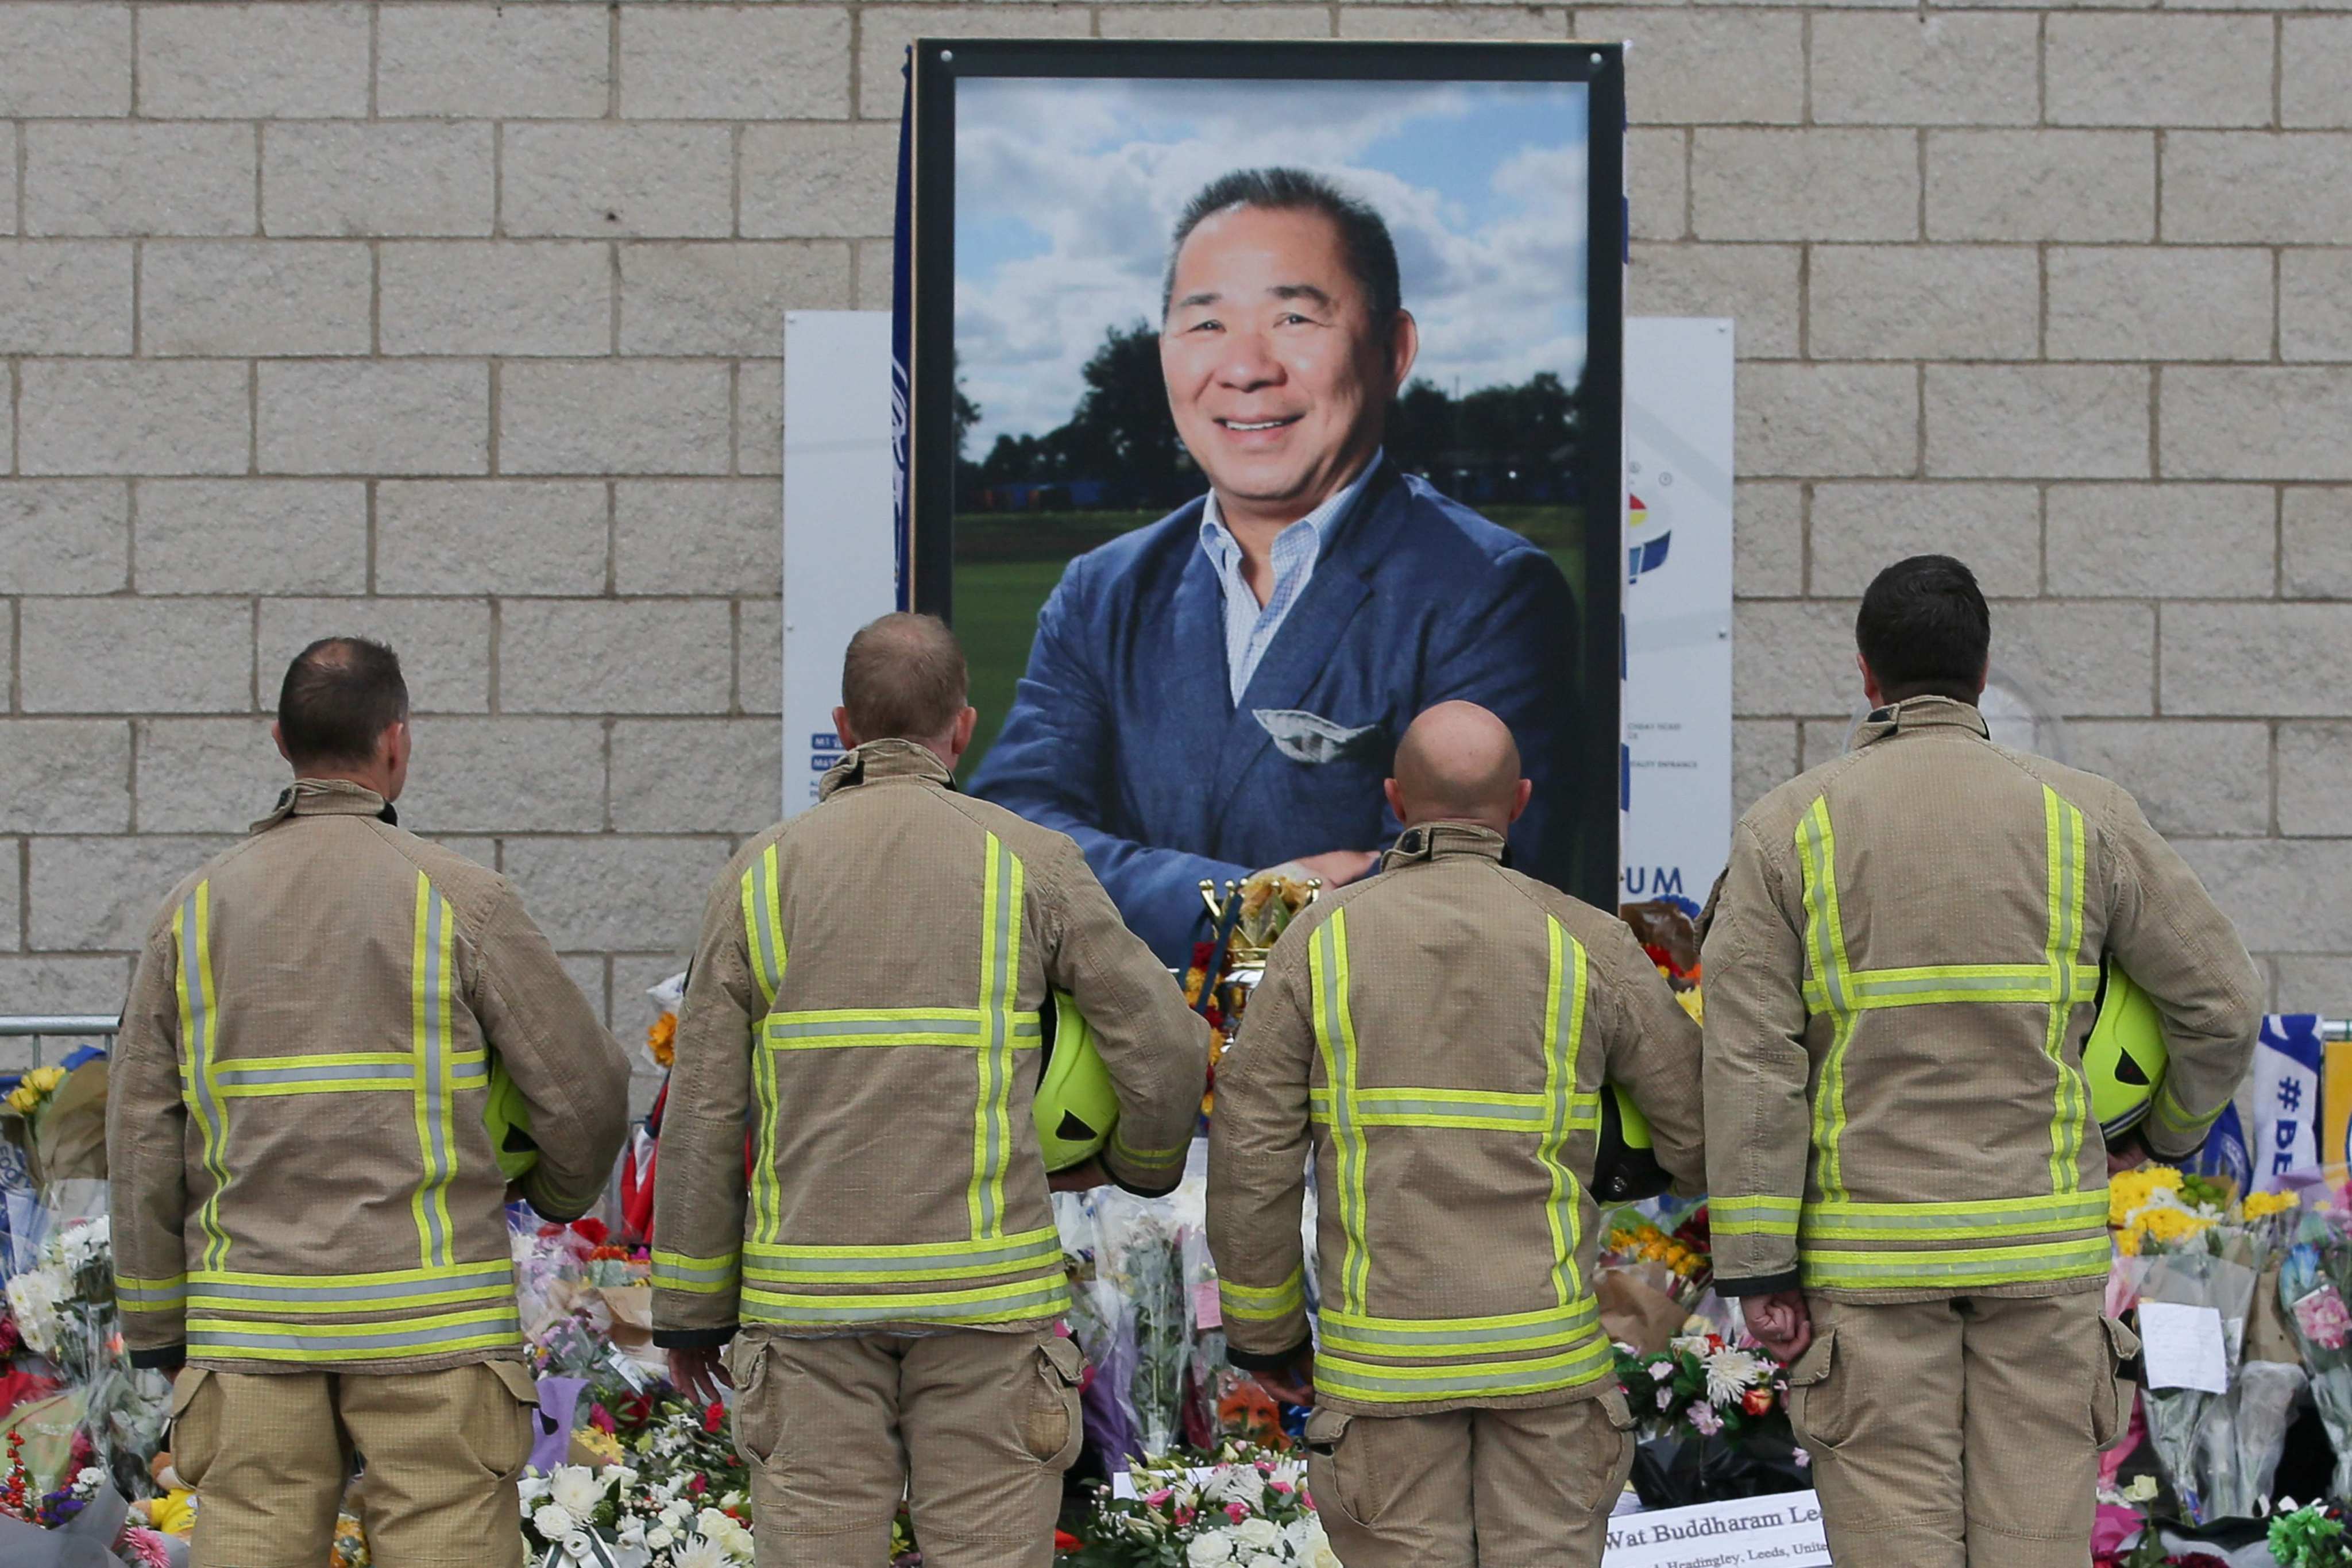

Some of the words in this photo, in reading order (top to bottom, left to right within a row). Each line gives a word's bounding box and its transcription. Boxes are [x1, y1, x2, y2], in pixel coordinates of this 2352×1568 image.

[1627, 867, 1682, 894] UM
[1606, 1530, 1647, 1550] Wat
[1651, 1512, 1784, 1543] Buddharam
[1747, 1546, 1790, 1560] Leeds,
